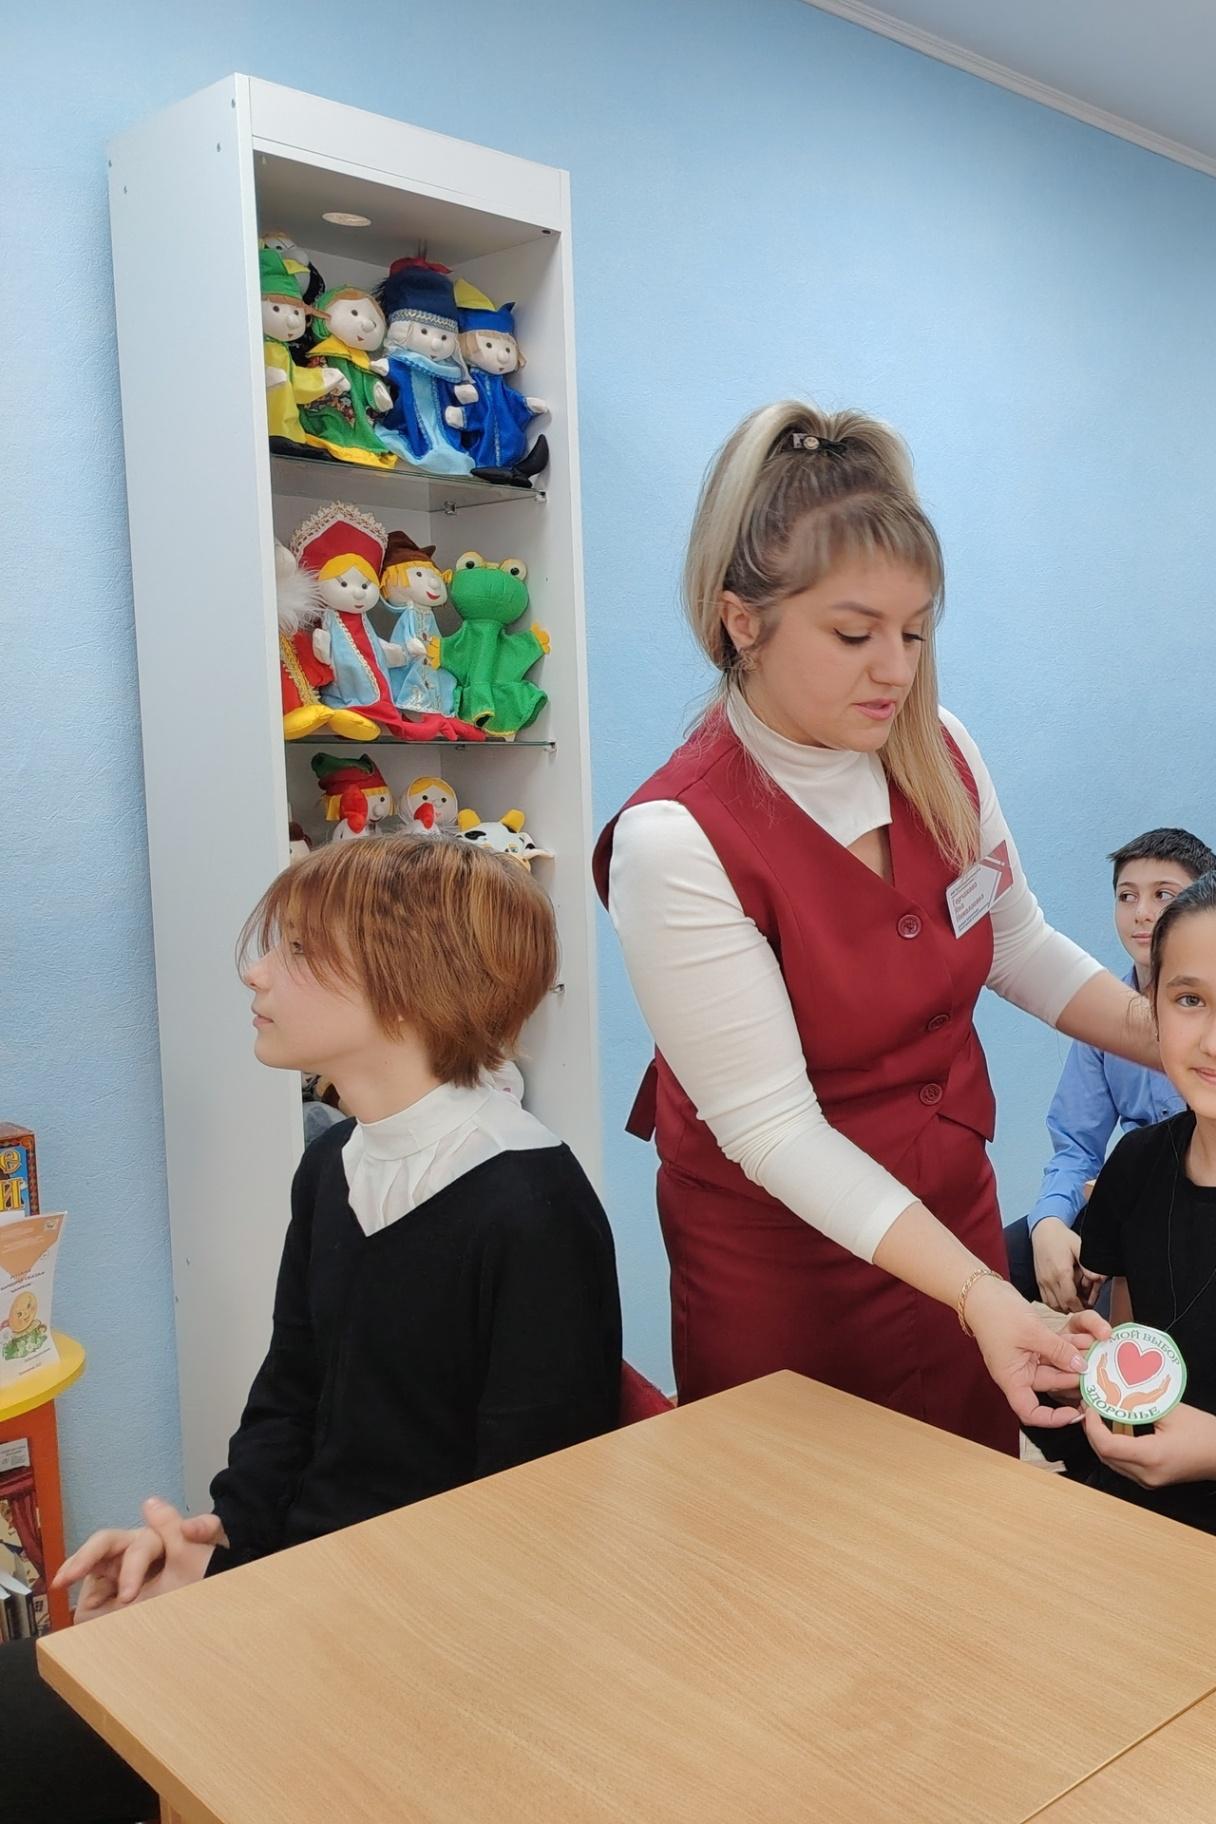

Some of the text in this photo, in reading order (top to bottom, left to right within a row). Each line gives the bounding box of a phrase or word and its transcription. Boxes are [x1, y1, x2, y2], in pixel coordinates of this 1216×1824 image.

[1109, 1329, 1180, 1365] МОЙ ВЫБОР
[1086, 1384, 1160, 1419] ЗДОРОВЬЕ
